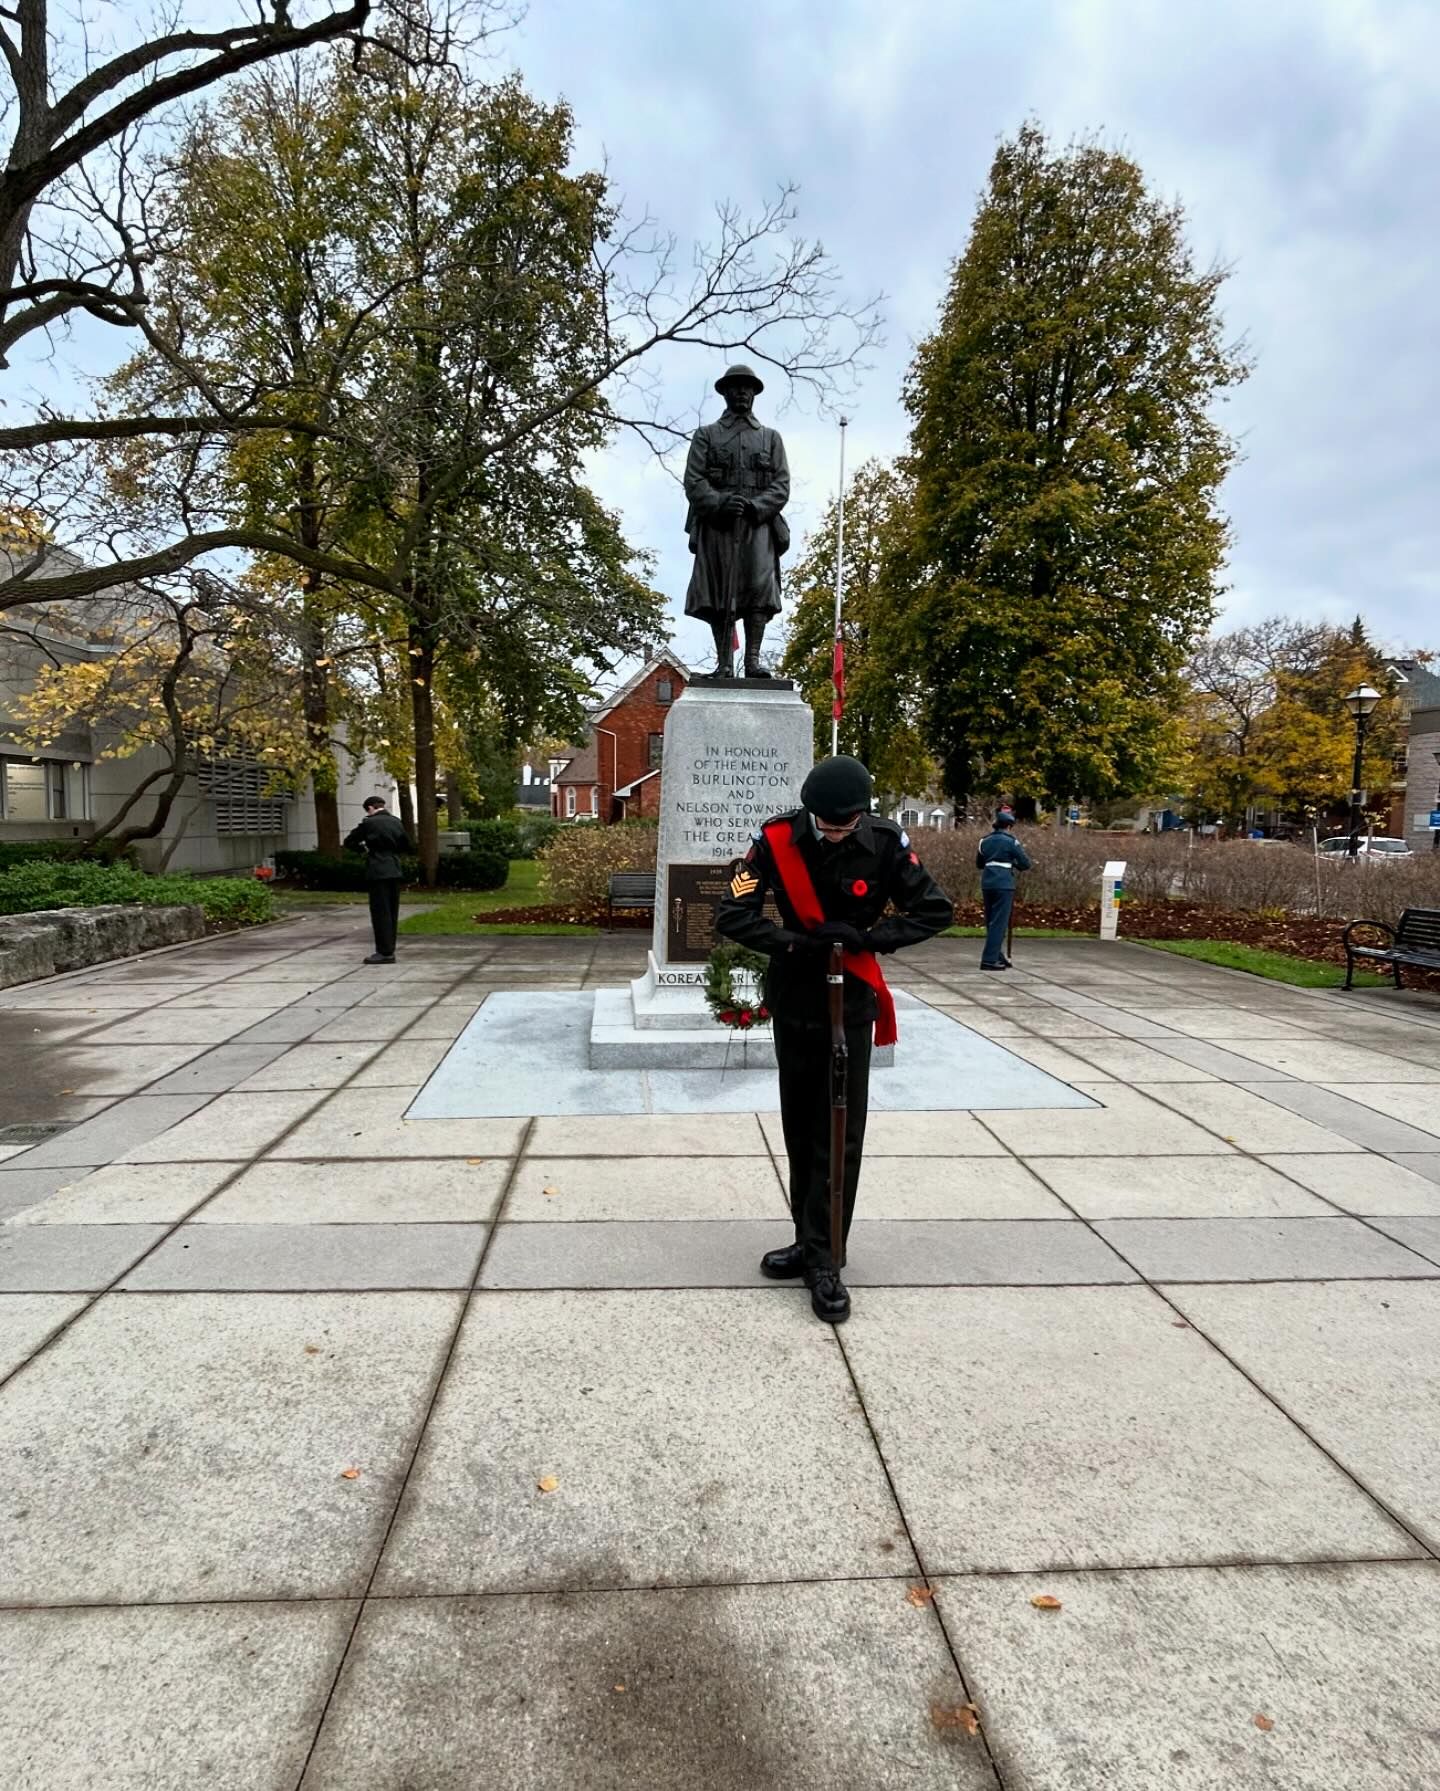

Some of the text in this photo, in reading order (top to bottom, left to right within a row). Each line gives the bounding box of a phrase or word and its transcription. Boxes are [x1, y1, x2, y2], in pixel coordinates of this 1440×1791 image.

[705, 746, 778, 758] IN HONOUR
[694, 760, 789, 772] OF THE MEN OF
[692, 774, 789, 787] BURLINGTON
[727, 790, 755, 800] AND
[676, 802, 729, 814] NELSON
[694, 817, 722, 828] WHO
[684, 830, 710, 842] THE
[711, 847, 734, 857] 1914
